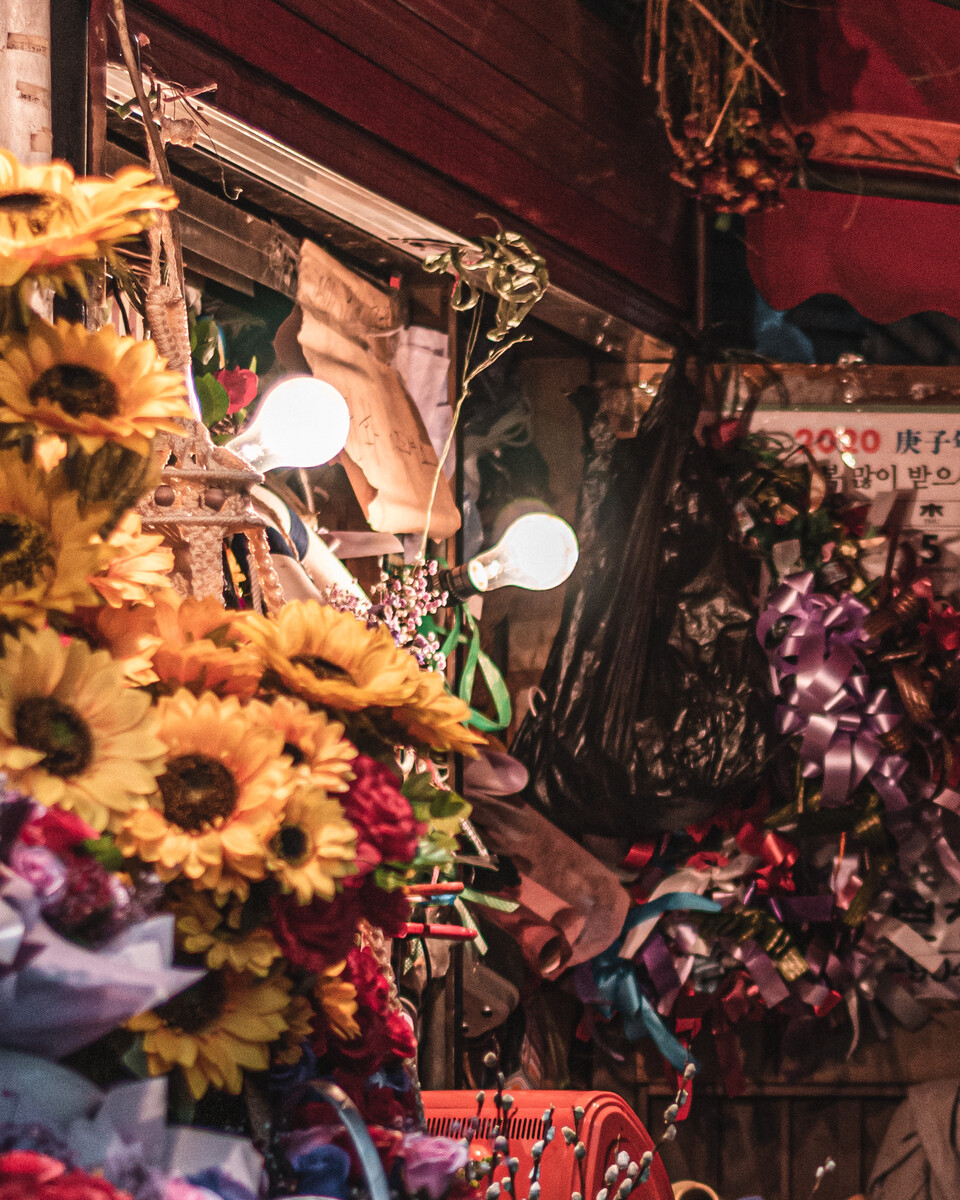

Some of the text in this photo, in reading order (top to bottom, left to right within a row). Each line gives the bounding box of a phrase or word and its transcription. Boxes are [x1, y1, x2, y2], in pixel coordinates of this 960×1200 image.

[795, 428, 881, 455] 2020
[853, 464, 897, 490] 많이
[921, 535, 942, 565] 5
